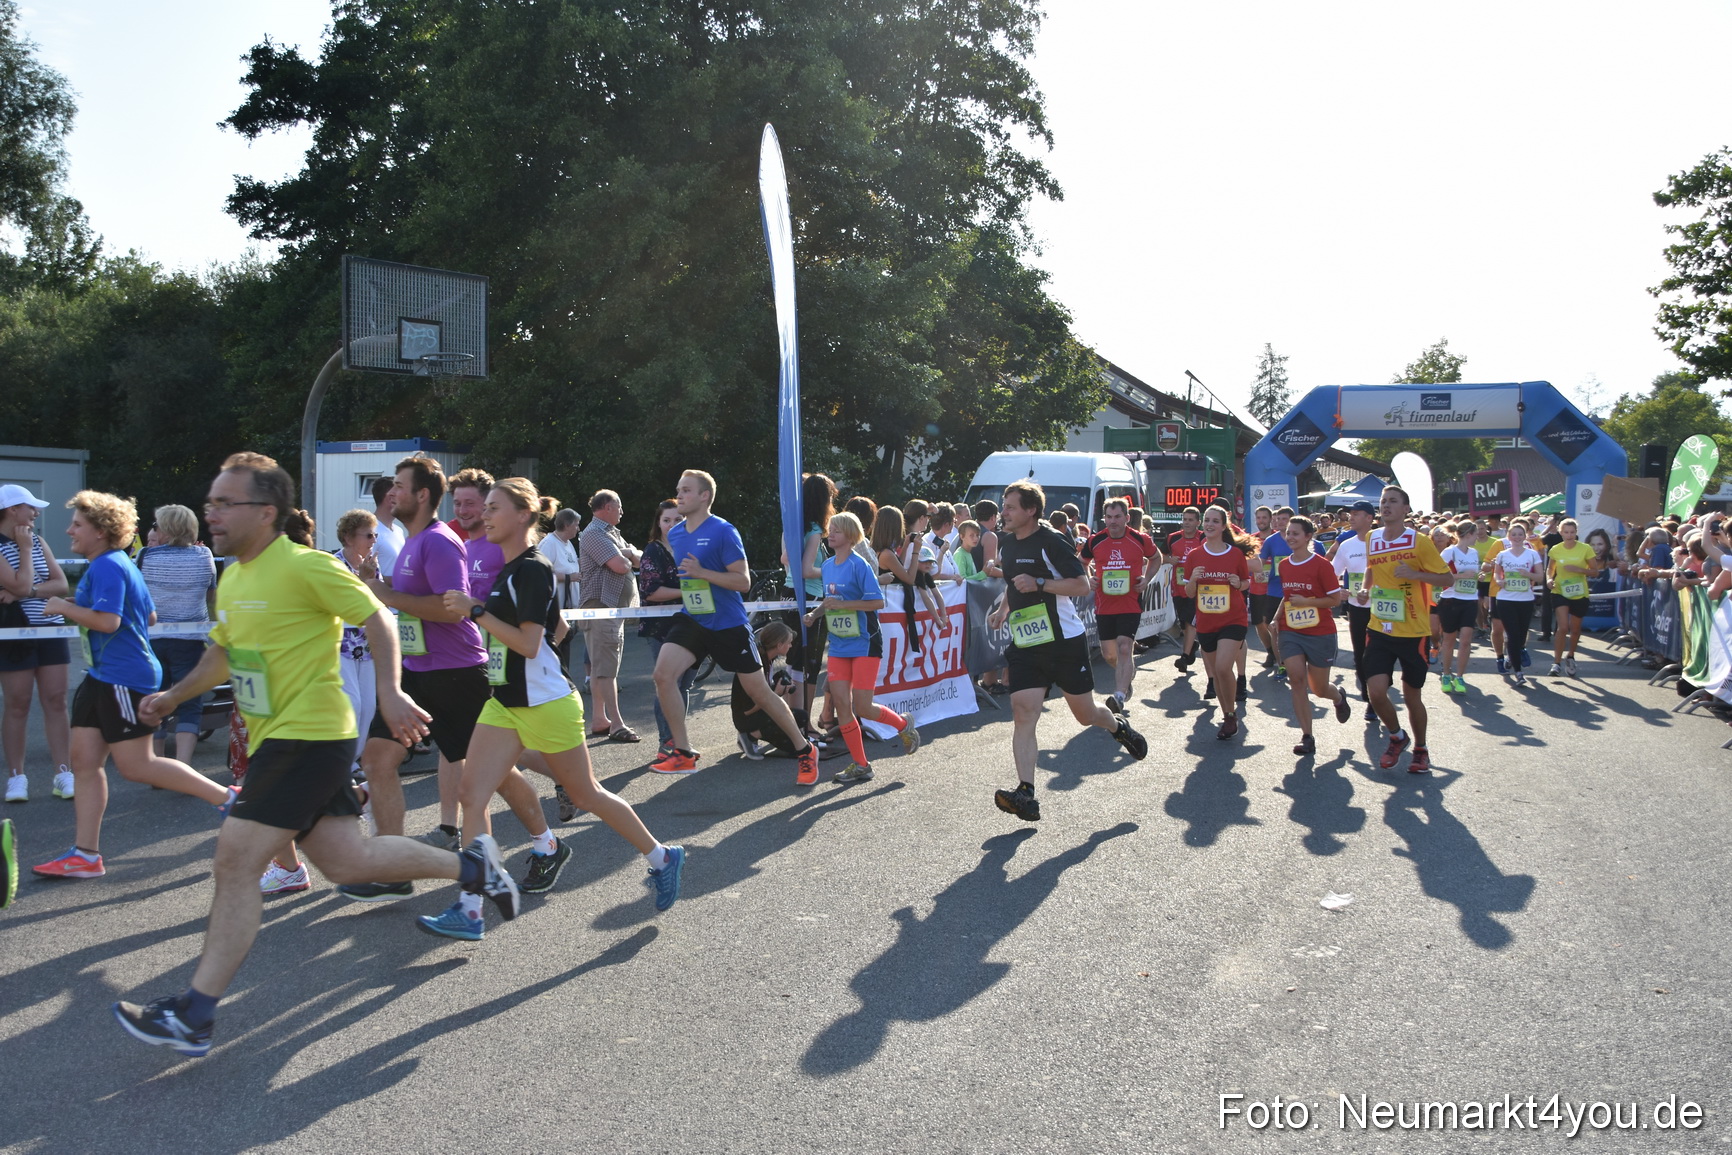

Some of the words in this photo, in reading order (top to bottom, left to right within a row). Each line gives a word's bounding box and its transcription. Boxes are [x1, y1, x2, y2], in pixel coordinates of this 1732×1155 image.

[1410, 410, 1477, 422] firmenlauf
[1283, 431, 1319, 442] Fischer
[1474, 482, 1498, 499] RW
[1369, 556, 1387, 566] MAX
[1390, 552, 1416, 562] BÖGL
[473, 560, 483, 571] K
[1199, 571, 1229, 579] EUMARKT
[1107, 580, 1124, 589] 967
[1458, 579, 1476, 589] 1502
[1506, 579, 1526, 588] 1516
[1565, 584, 1580, 593] 672
[689, 593, 702, 605] 15
[1201, 596, 1226, 606] 1411
[1377, 601, 1398, 613] 876
[1289, 608, 1316, 622] 1412
[832, 617, 852, 629] 476
[1016, 619, 1048, 638] 1084
[232, 673, 255, 699] 71
